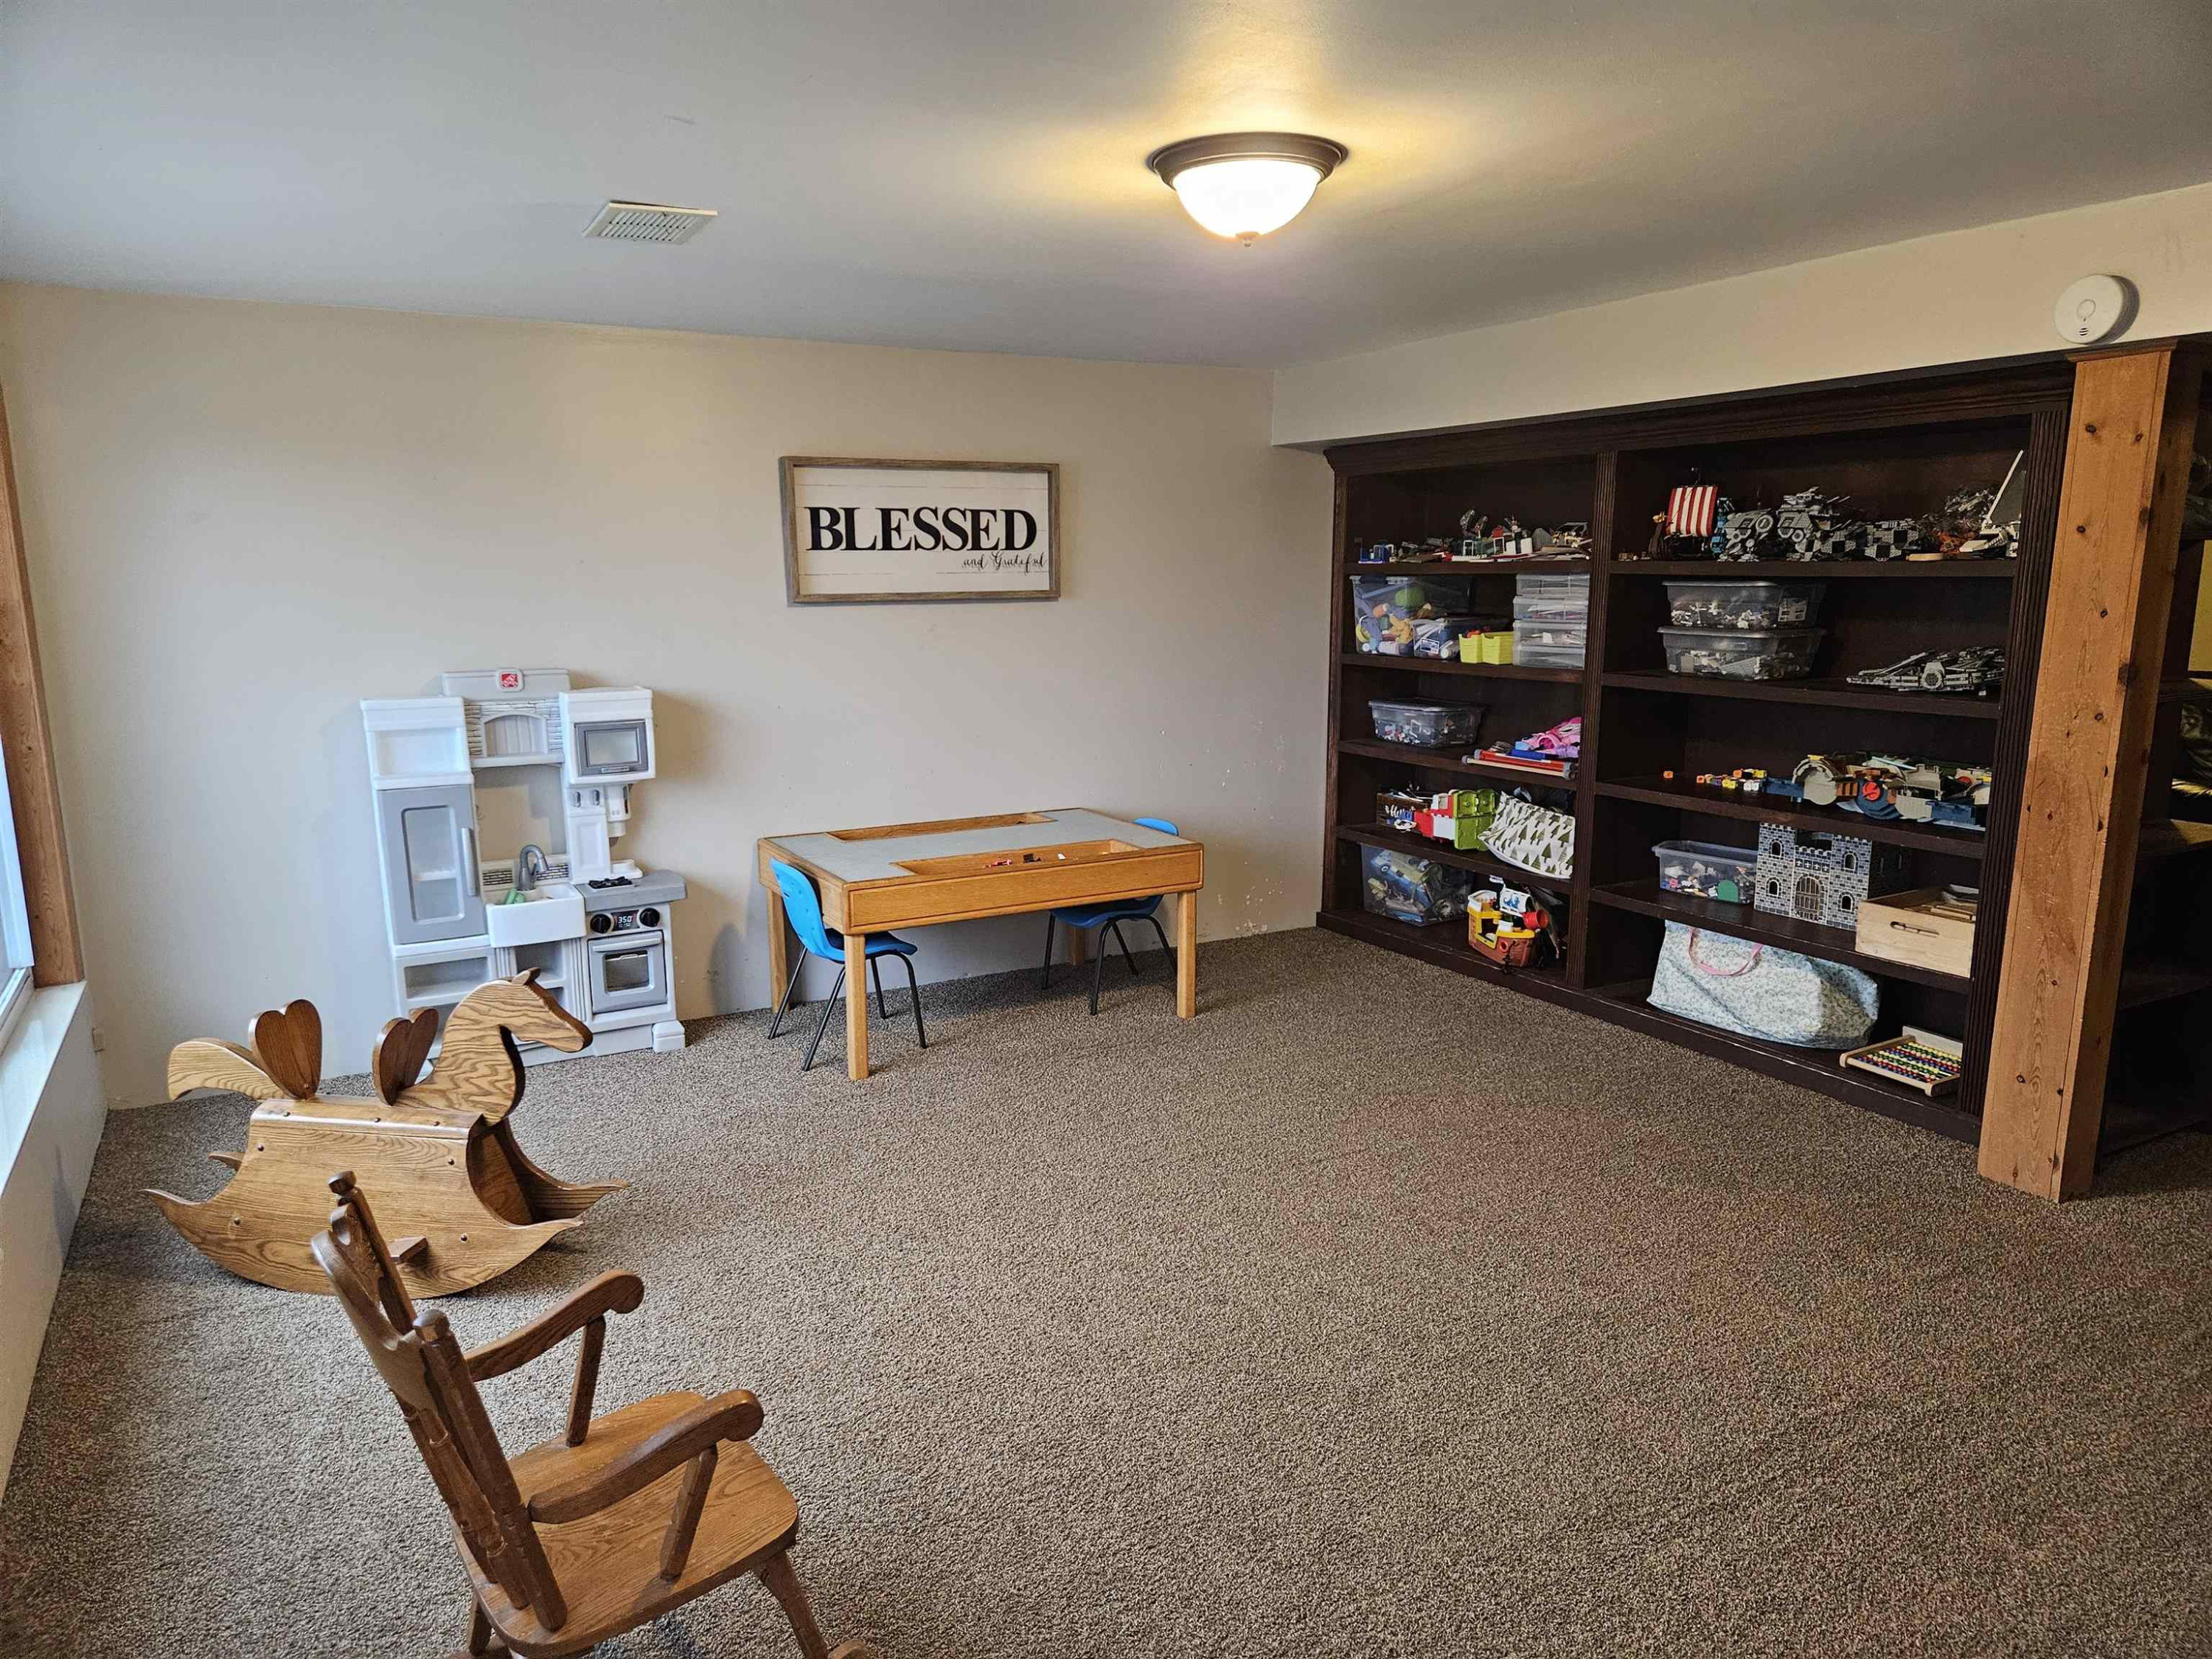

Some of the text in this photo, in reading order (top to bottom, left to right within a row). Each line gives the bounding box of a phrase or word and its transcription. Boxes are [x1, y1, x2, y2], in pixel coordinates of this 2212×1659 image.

[805, 506, 1037, 551] BLESSED
[962, 549, 1047, 574] and Grateful
